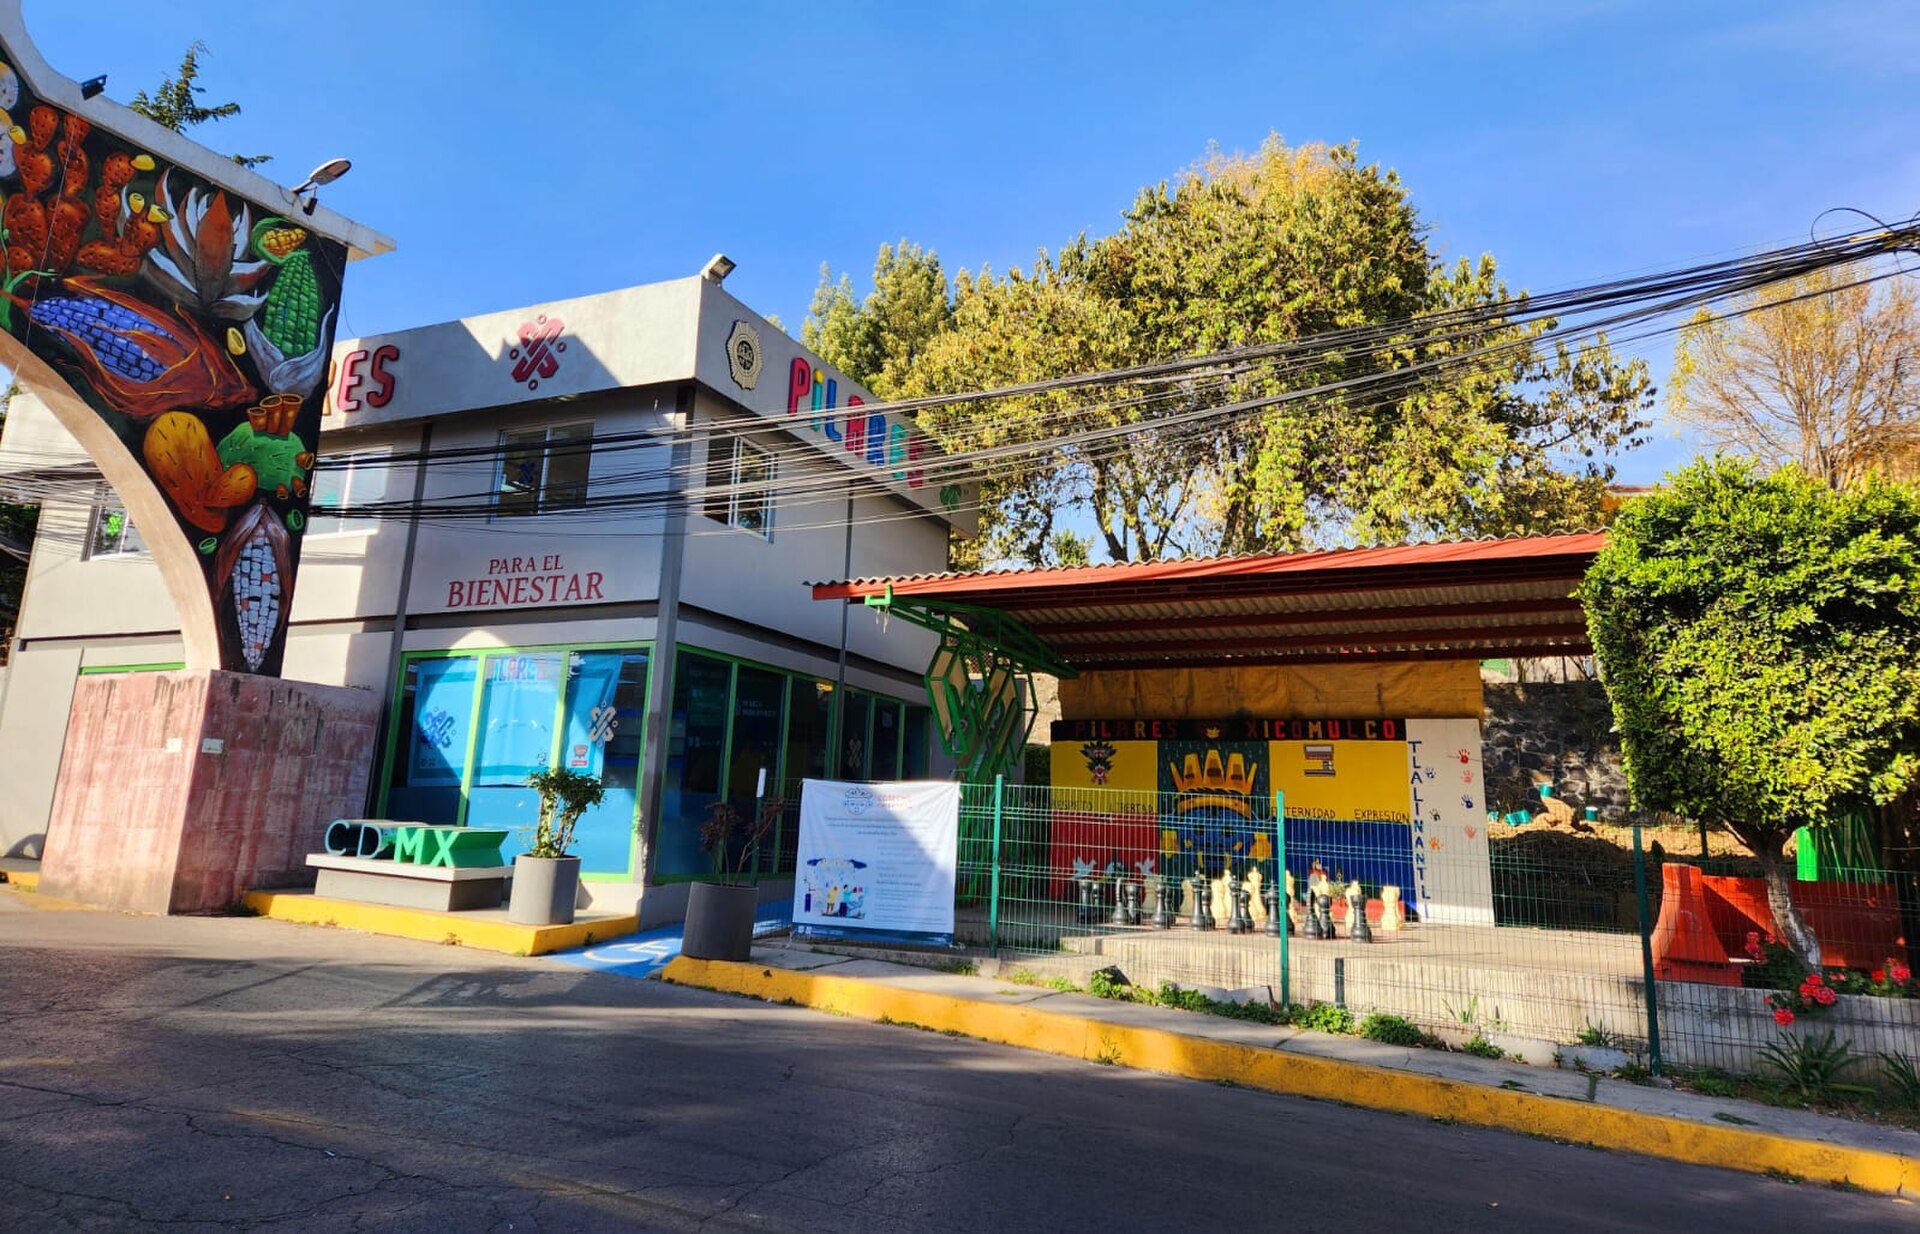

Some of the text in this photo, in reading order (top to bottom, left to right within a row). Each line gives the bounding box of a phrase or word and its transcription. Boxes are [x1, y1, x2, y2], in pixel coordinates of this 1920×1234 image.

[488, 554, 564, 575] PARA EL
[445, 571, 604, 608] BIENESTAR
[1247, 719, 1396, 739] XICOMULCO
[325, 817, 461, 868] CDMX
